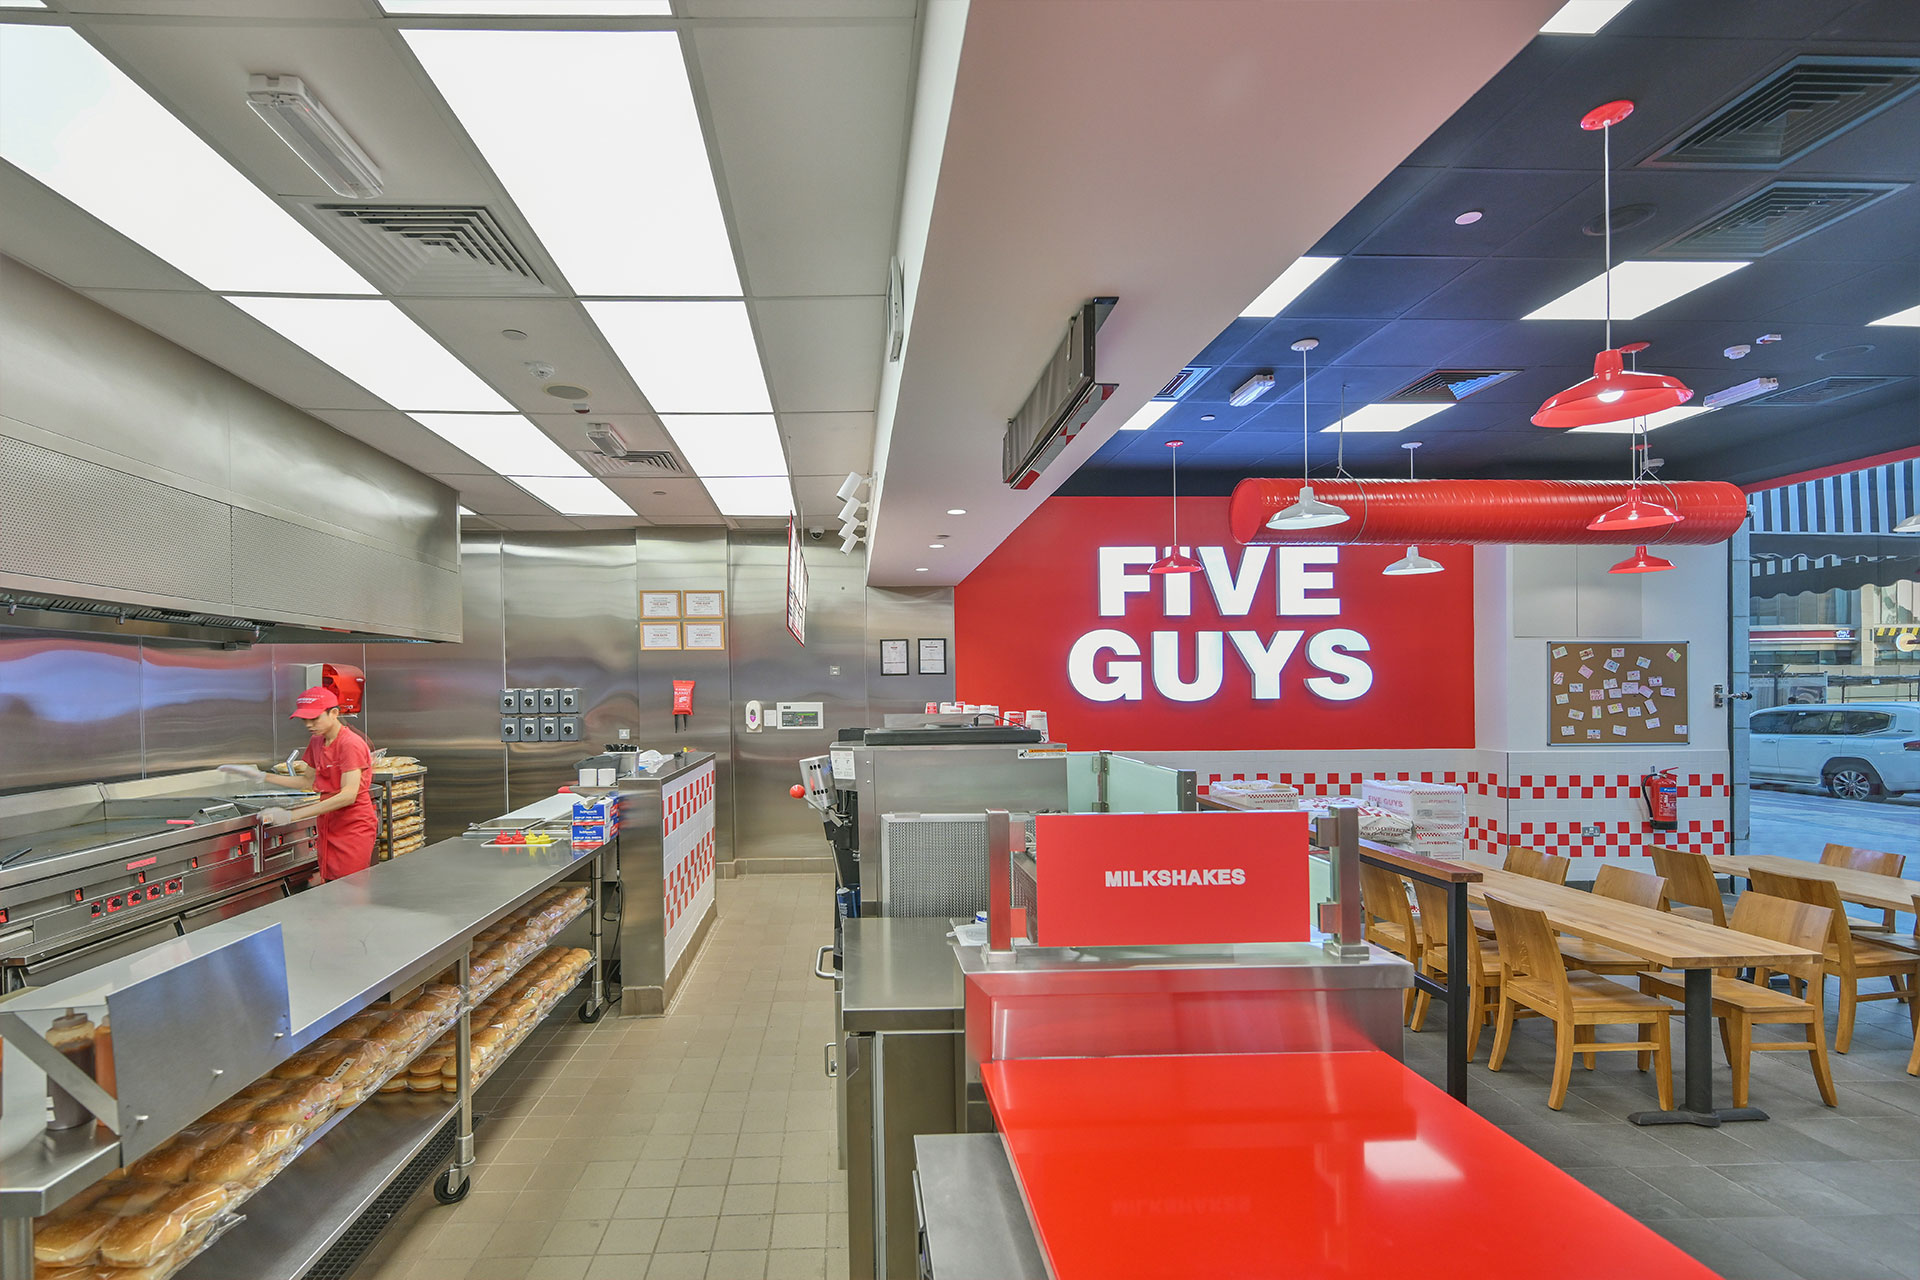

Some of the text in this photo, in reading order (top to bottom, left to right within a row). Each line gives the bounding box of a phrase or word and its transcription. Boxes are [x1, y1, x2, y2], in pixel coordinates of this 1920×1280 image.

[1097, 545, 1341, 617] FIVE
[1067, 627, 1374, 702] GUYS
[1367, 794, 1404, 808] FIVE GUYS
[1104, 868, 1247, 887] MILKSHAKES
